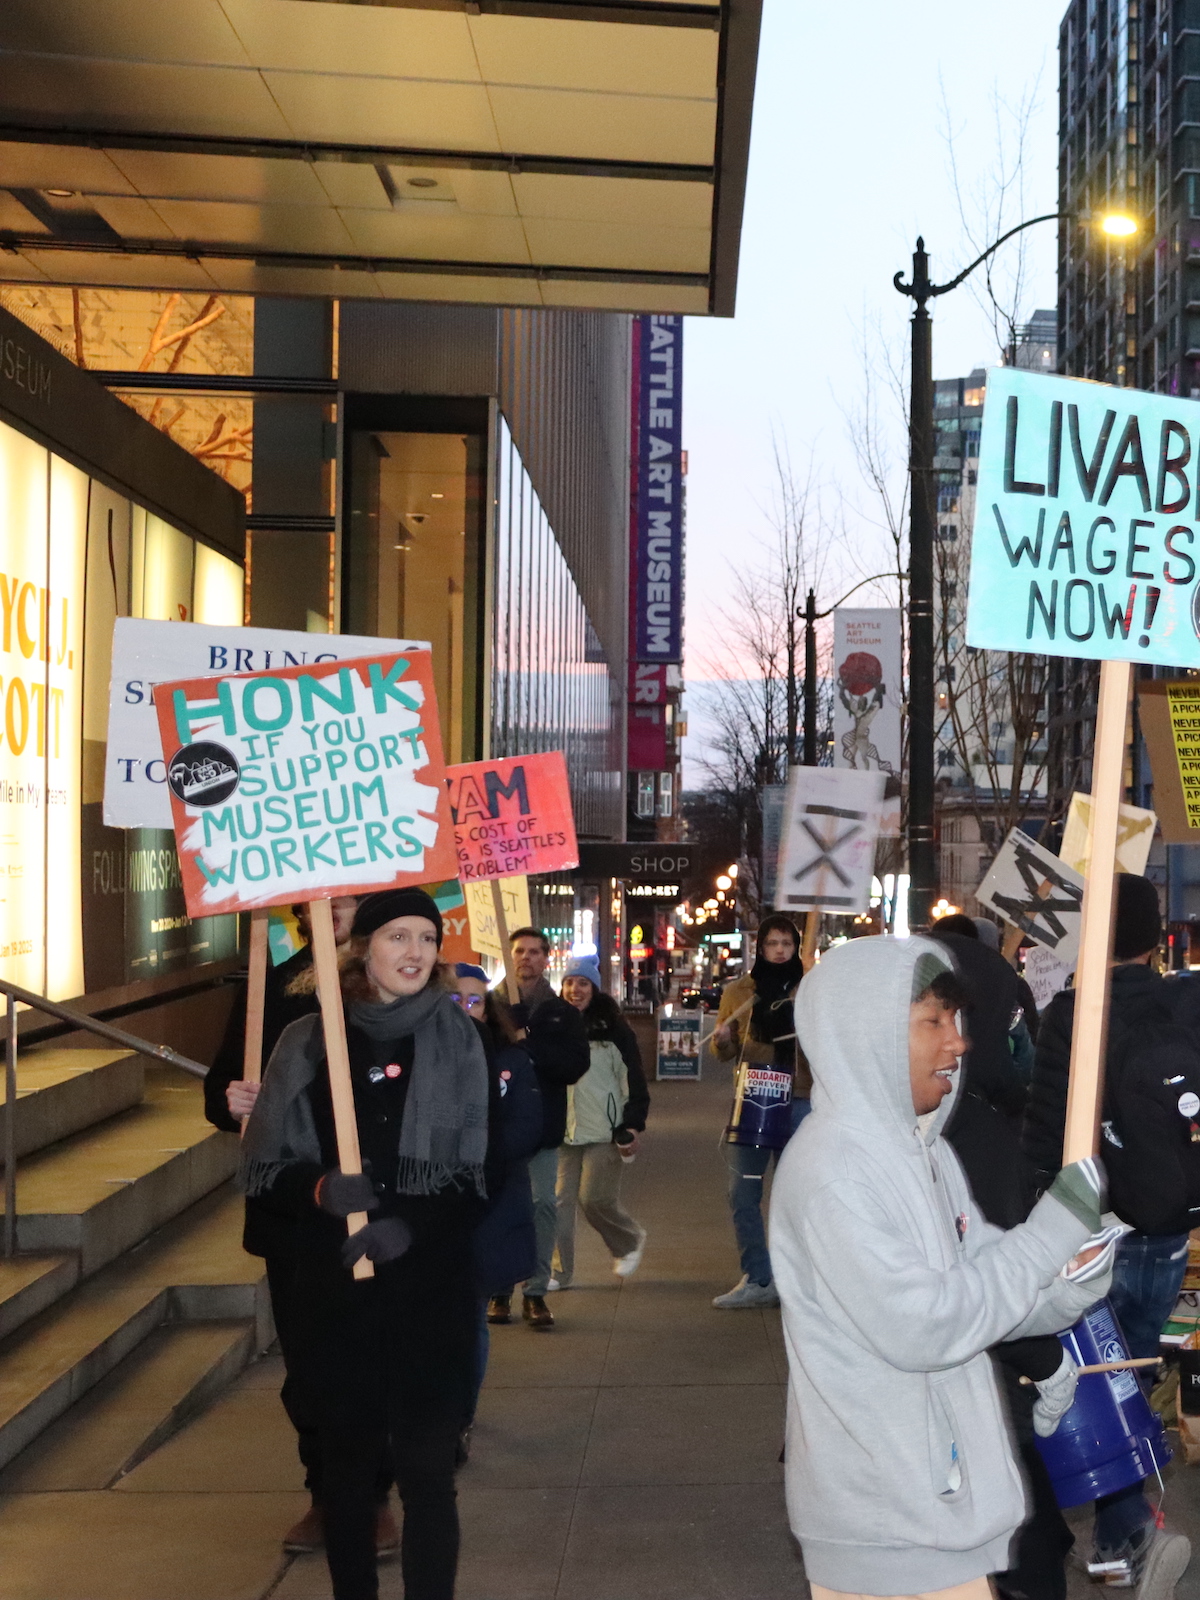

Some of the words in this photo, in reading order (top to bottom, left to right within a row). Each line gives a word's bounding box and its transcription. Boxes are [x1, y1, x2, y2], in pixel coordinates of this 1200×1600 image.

[0, 334, 52, 405] SEUM
[648, 435, 673, 504] ART
[992, 503, 1196, 585] WAGES
[647, 511, 672, 652] MUSEUM
[1026, 578, 1161, 648] NOW!
[172, 657, 421, 745] HONK
[1169, 687, 1200, 699] NEVER
[1172, 704, 1179, 714] A
[240, 731, 284, 761] IF
[301, 716, 366, 750] YOU
[1177, 733, 1183, 743] A
[238, 726, 425, 796] SUPPORT
[1182, 762, 1188, 771] A
[201, 777, 221, 788] UNION
[16, 781, 25, 804] in
[28, 783, 41, 809] My
[1186, 791, 1193, 800] A
[201, 775, 389, 847] MUSEUM
[1191, 818, 1198, 828] A
[469, 823, 508, 842] COST
[516, 818, 538, 833] OF
[195, 815, 424, 887] WORKERS
[480, 844, 494, 856] IS
[630, 857, 690, 873] SHOP
[747, 1070, 791, 1084] SOLIDARITY
[748, 1079, 788, 1089] FOREVER!
